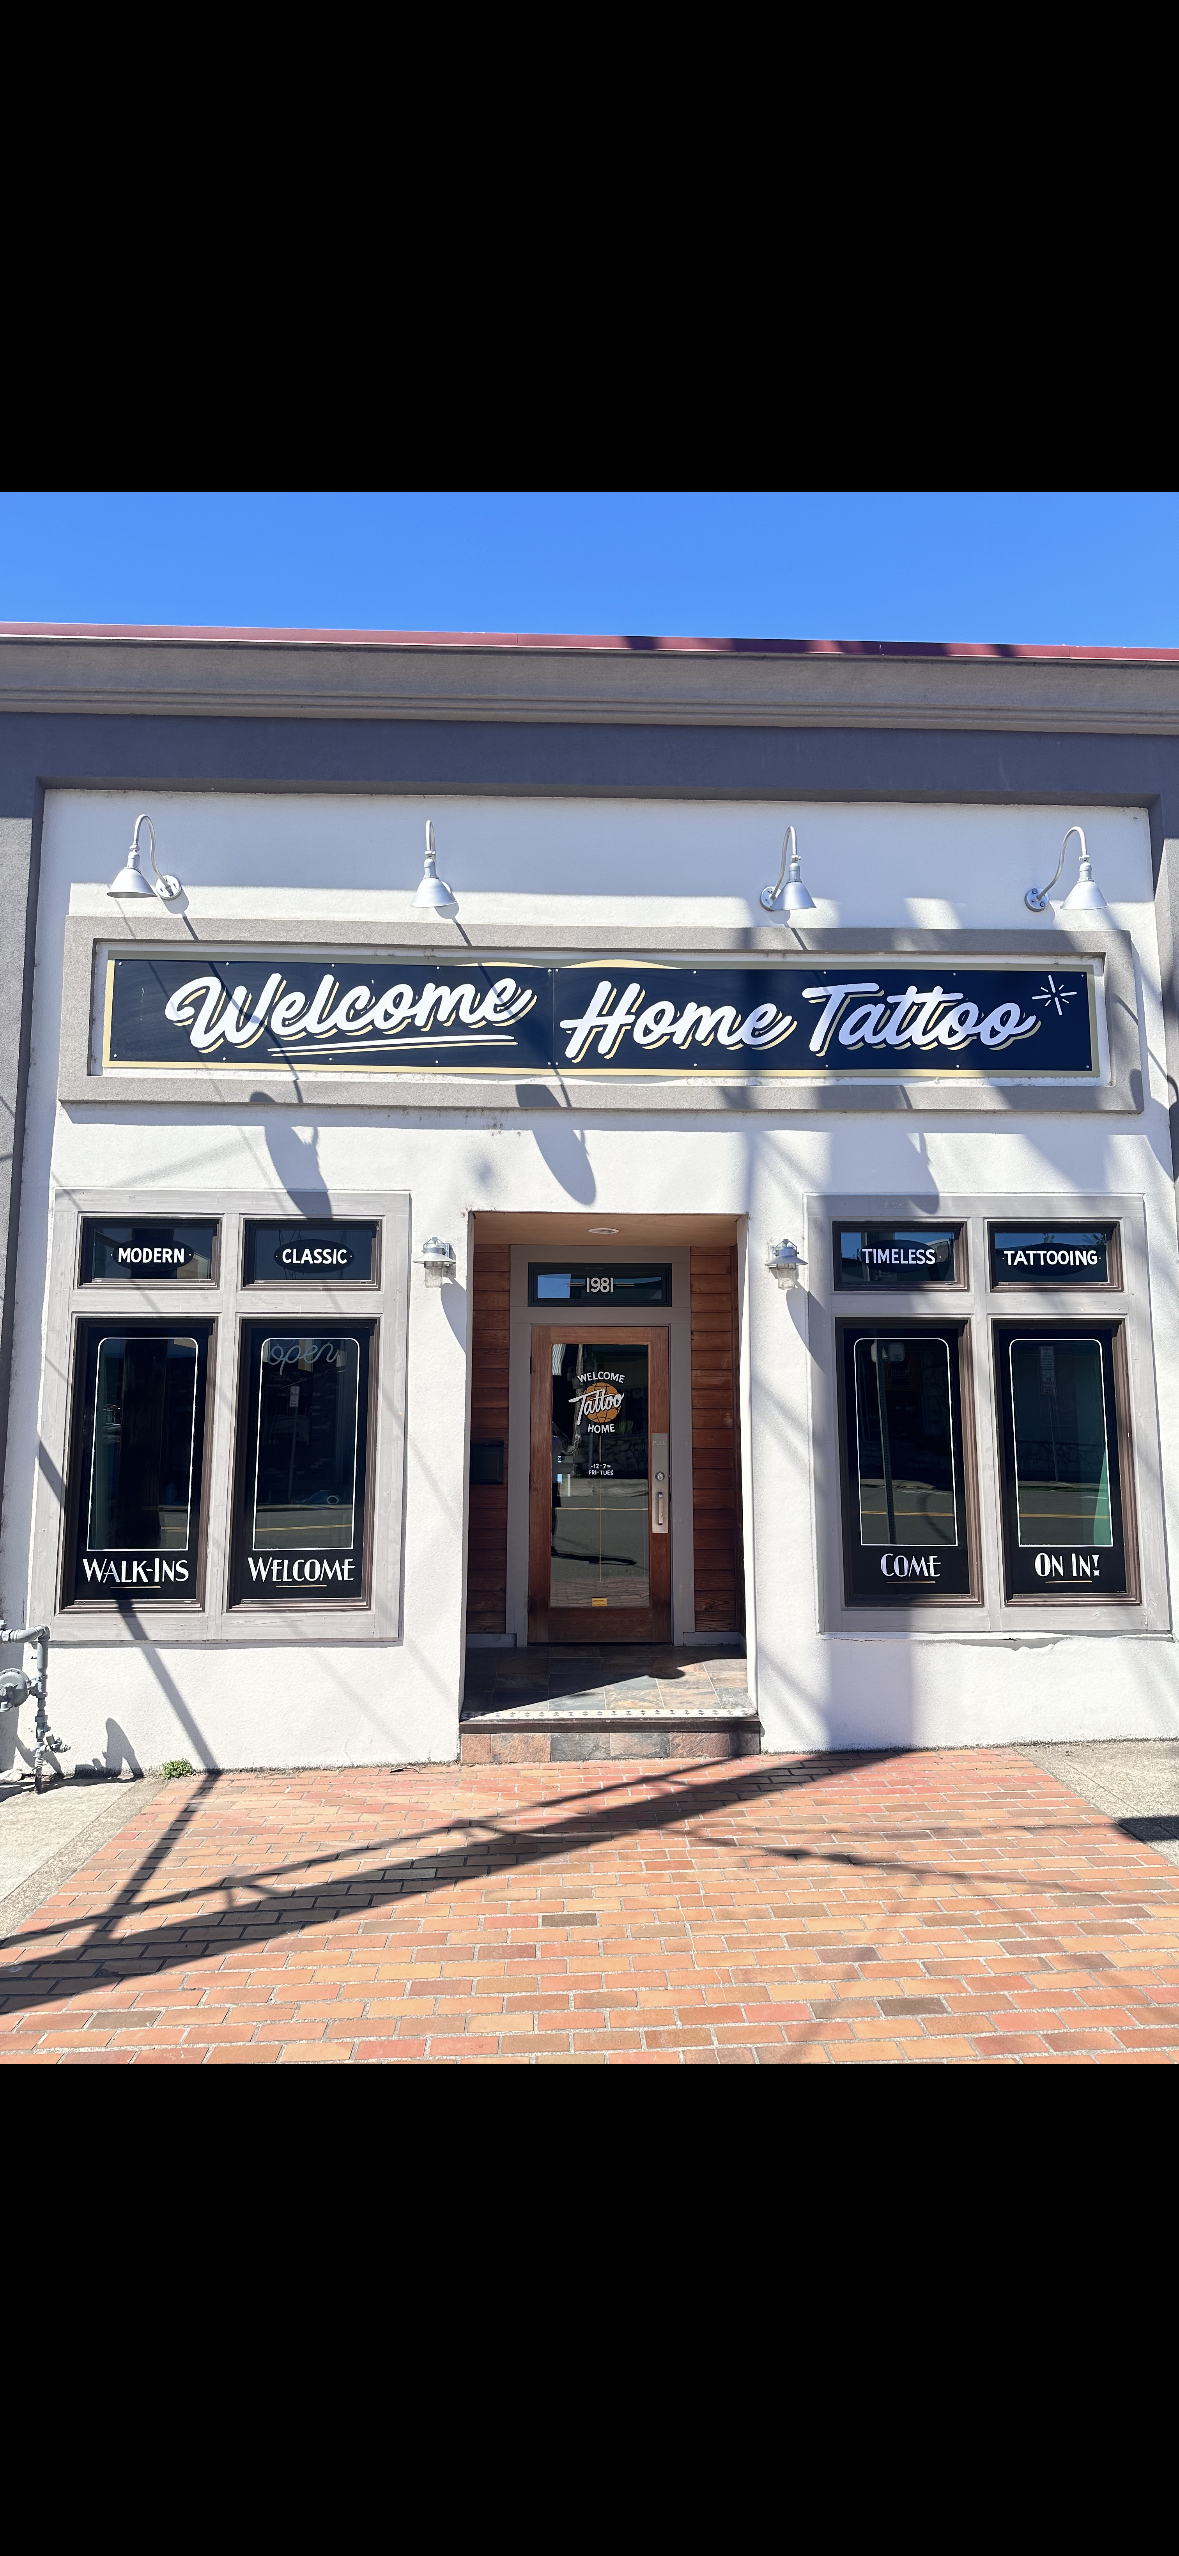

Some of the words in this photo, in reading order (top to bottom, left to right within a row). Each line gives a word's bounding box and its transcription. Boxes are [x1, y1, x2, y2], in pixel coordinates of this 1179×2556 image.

[164, 973, 537, 1054] Welcome
[560, 980, 797, 1063] Home
[802, 982, 1041, 1057] Tattoo
[117, 1247, 185, 1263] MODERN
[282, 1248, 348, 1265] CLASSIC
[862, 1248, 936, 1265] TIMELESS
[1004, 1250, 1098, 1266] TATTOOING
[586, 1277, 614, 1293] 1981
[267, 1341, 339, 1376] open
[577, 1371, 626, 1384] WELCOME
[568, 1389, 625, 1426] Tattoo
[587, 1423, 616, 1434] HOME
[83, 1557, 189, 1583] WALK-INS
[247, 1557, 356, 1582] WELCOME
[880, 1553, 942, 1577] COME
[1034, 1552, 1064, 1577] ON
[1071, 1553, 1101, 1577] IN!
